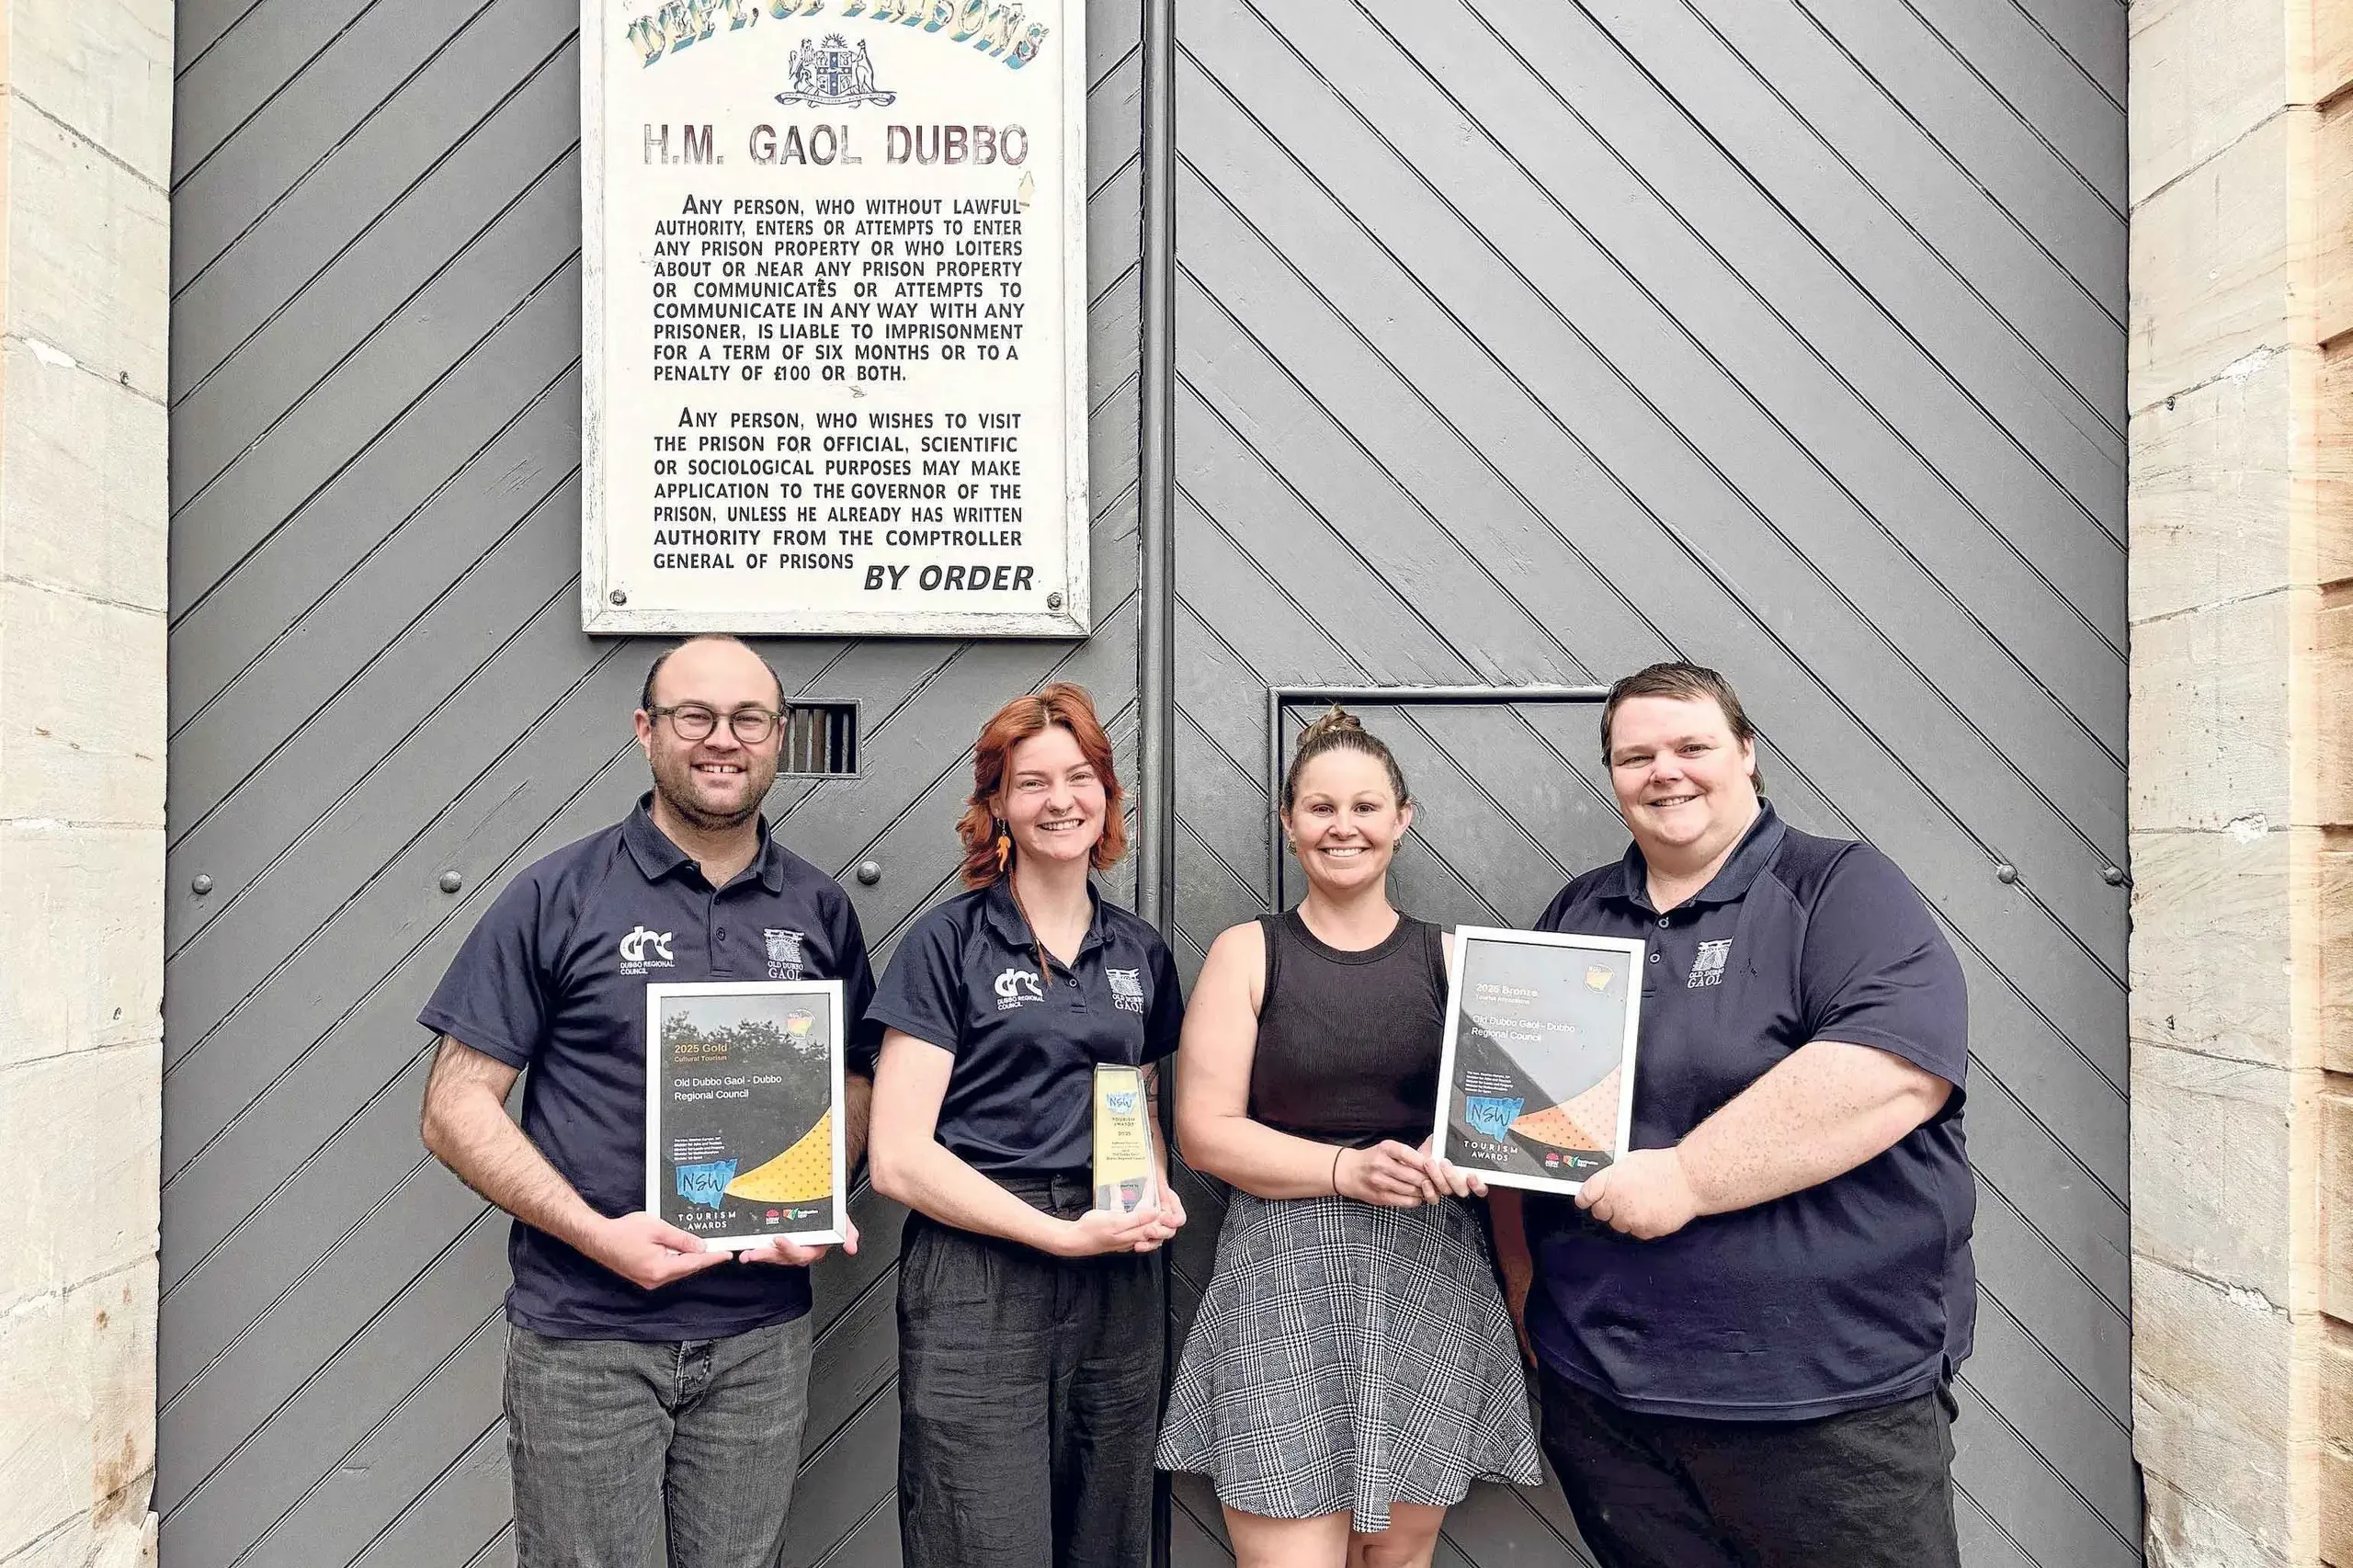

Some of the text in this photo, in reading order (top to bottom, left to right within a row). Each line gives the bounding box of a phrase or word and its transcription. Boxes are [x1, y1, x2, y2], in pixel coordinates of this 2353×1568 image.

[644, 124, 1028, 165] H.M. GAOL DUBBO
[682, 194, 1020, 216] ANY PERSON, WHO WITHOUT LAWFUL
[655, 220, 1021, 237] AUTHORITY, ENTERS OR ATTEMPTS TO ENTER
[654, 241, 1022, 256] ANY PRISON PROPERTY OR WHO LOITERS
[654, 262, 1022, 277] ABOUT OR NEAR ANY PRISON PROPERTY
[654, 281, 1021, 298] OR COMMUNICATES OR ATTEMPTS TO
[654, 303, 1024, 318] COMMUNICATE IN ANY WAY WITH ANY
[654, 324, 1023, 340] PRISONER, IS LIABLE TO IMPRISONMENT
[654, 345, 1018, 360] FOR A TERM OF SIX MONTHS OR TO A
[654, 366, 905, 381] PENALTY OF £100 OR BOTH.
[678, 407, 1020, 430] ANY PERSON, WHO WISHES TO VISIT
[654, 437, 1017, 453] THE PRISON FOR OFFICIAL, SCIENTIFIC
[654, 460, 1020, 475] OR SOCIOLOGICAL PURPOSES MAY MAKE
[654, 483, 1020, 499] APPLICATION TO THE GOVERNOR OF THE
[654, 506, 1021, 523] PRISON, UNLESS HE ALREADY HAS WRITTEN
[654, 530, 1022, 546] AUTHORITY FROM THE COMPTROLLER
[654, 553, 853, 569] GENERAL OF PRISONS
[864, 565, 1033, 591] BY ORDER
[768, 968, 801, 981] GAOL
[1688, 975, 1722, 989] GAOL
[1502, 985, 1539, 997] Bronze
[1115, 999, 1144, 1014] GAOL
[1472, 1015, 1487, 1024] Old
[1489, 1017, 1518, 1028] Dubbo
[1546, 1022, 1575, 1033] Dubbo
[1471, 1027, 1541, 1042] Regional Council
[675, 1043, 728, 1054] 2025 Gold
[674, 1078, 690, 1087] Old
[692, 1077, 722, 1087] Dubbo
[723, 1075, 745, 1085] Gaol
[753, 1074, 782, 1085] Dubbo
[674, 1088, 749, 1102] Regional Council
[1471, 1104, 1511, 1127] NSW
[1463, 1141, 1518, 1154] TOURISM
[1471, 1151, 1508, 1162] AWARDS
[683, 1172, 725, 1192] NSW
[678, 1210, 736, 1221] TOURISM
[688, 1221, 727, 1231] AWARDS
